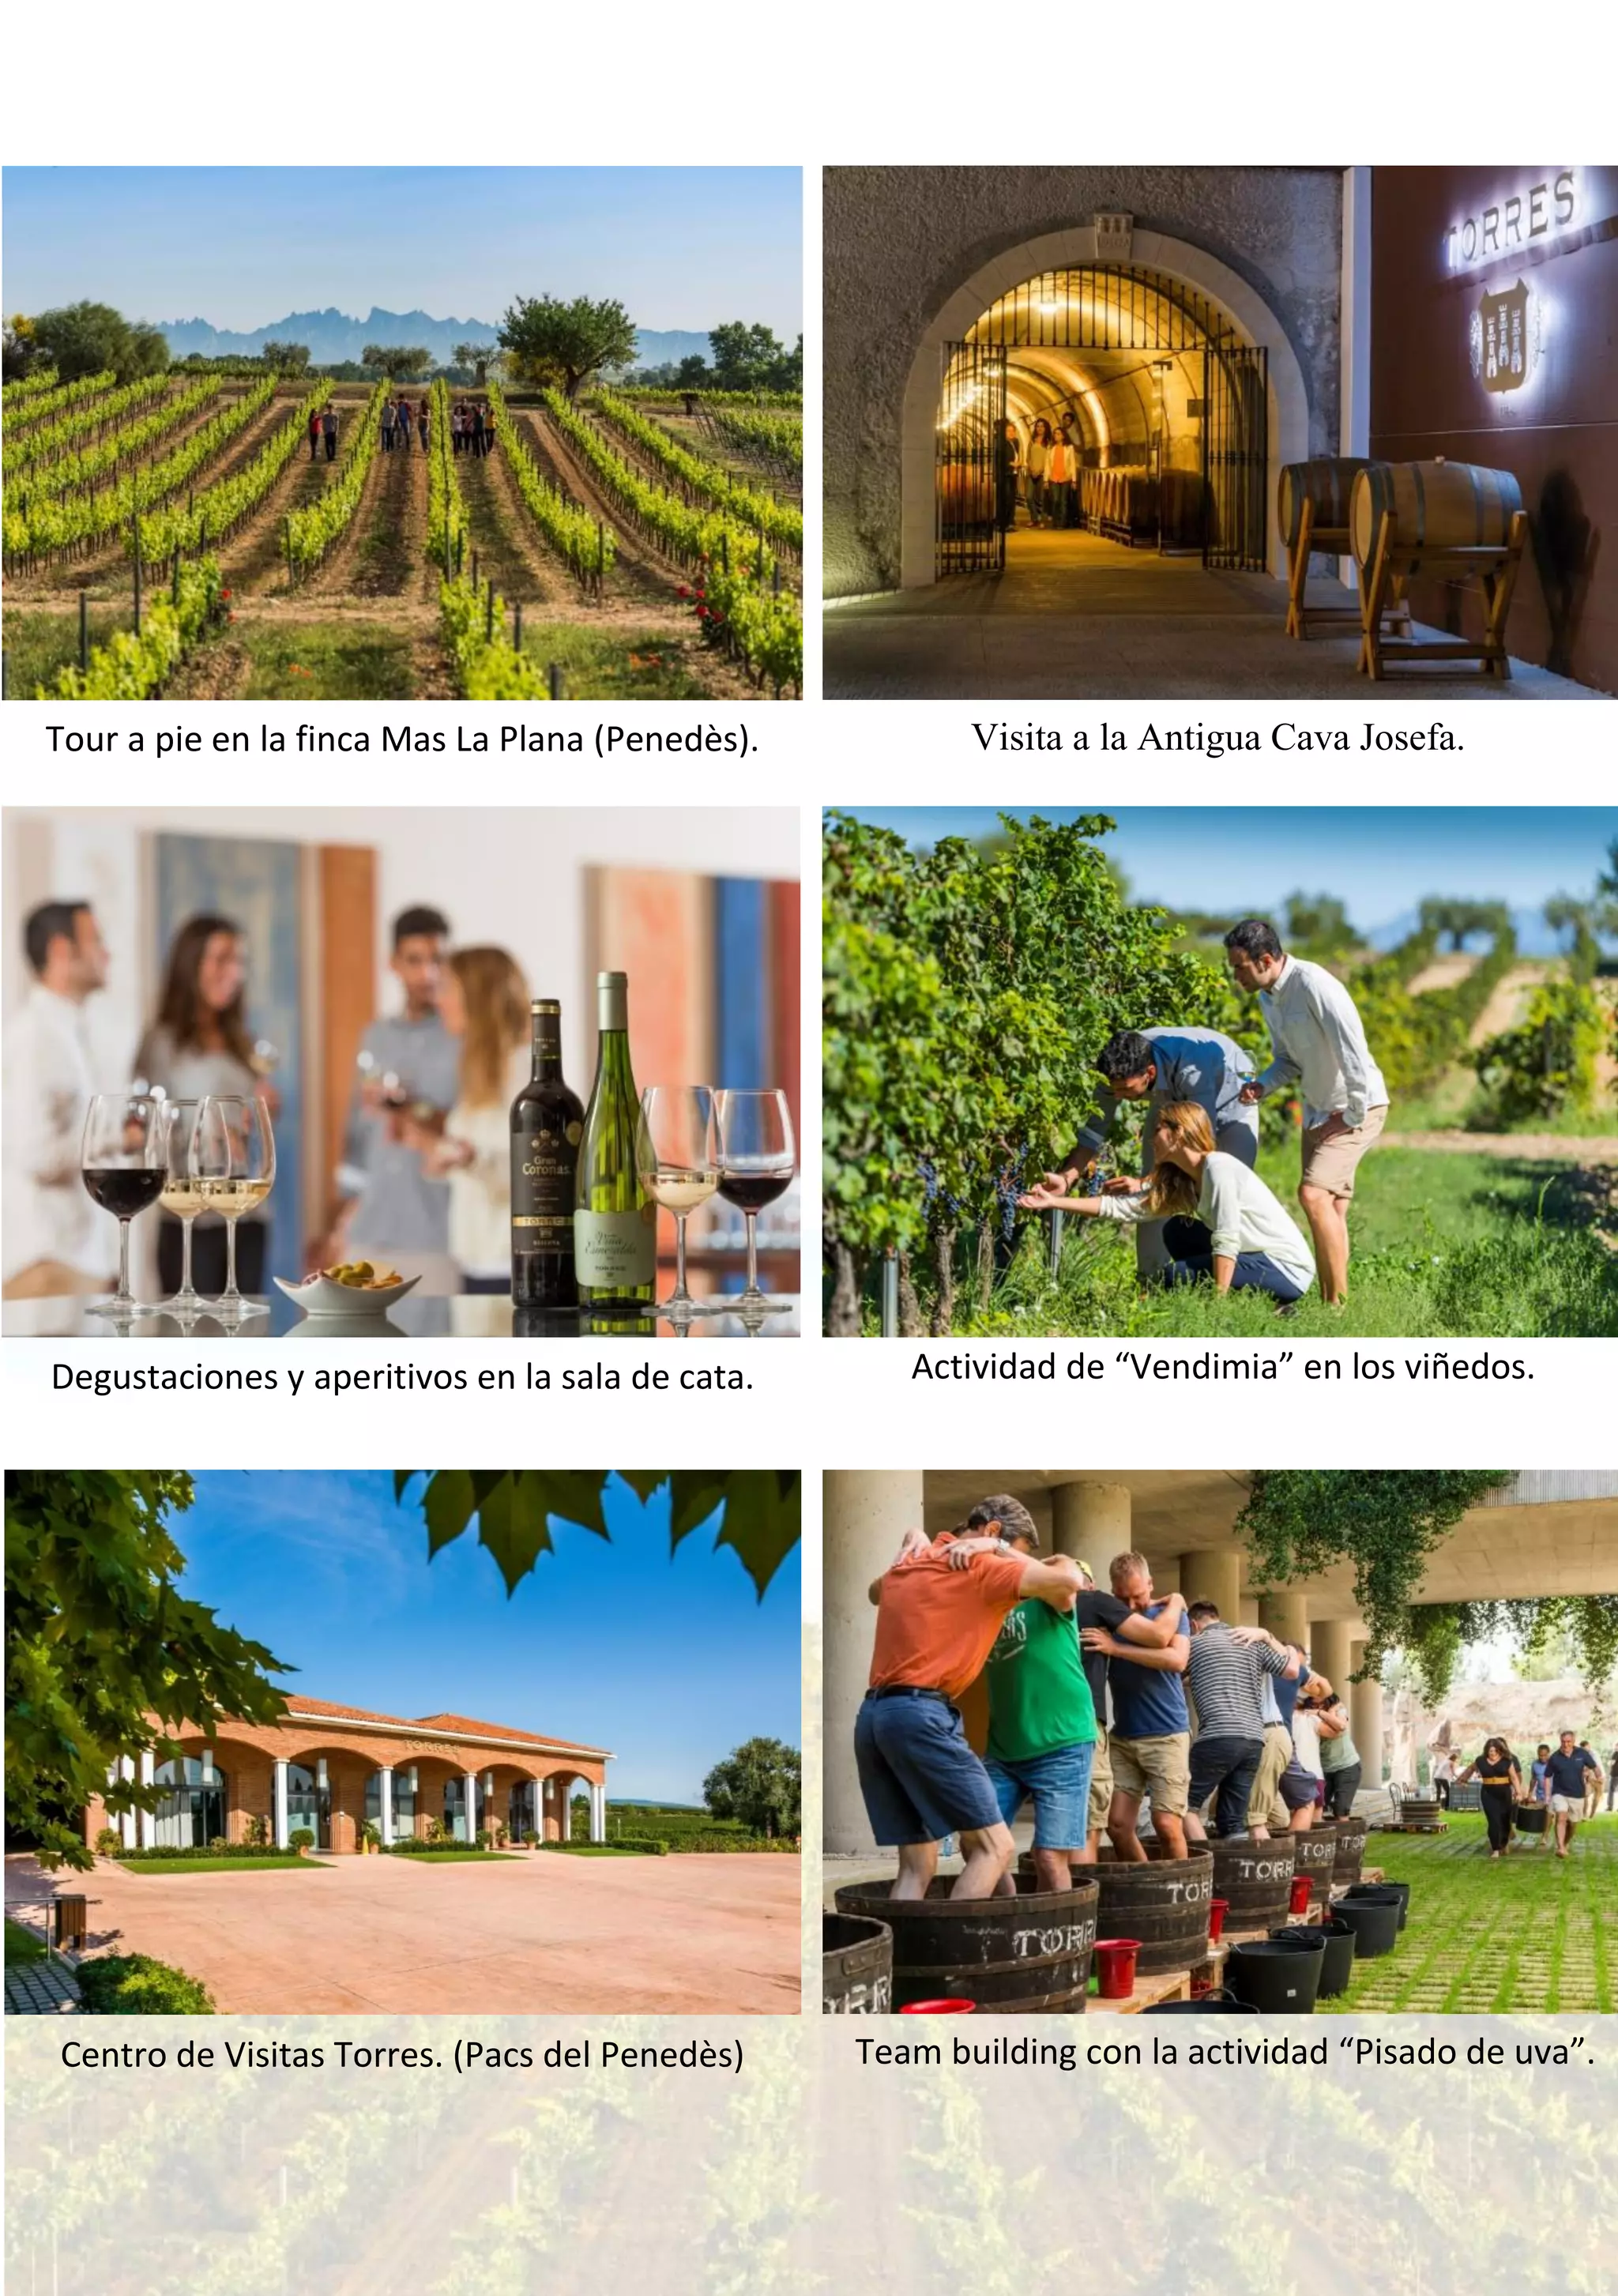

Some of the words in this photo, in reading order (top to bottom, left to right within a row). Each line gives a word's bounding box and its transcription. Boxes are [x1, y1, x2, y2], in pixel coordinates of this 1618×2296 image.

[1444, 171, 1574, 276] TORRES
[534, 1157, 556, 1165] Gran
[522, 1163, 571, 1175] Coronas
